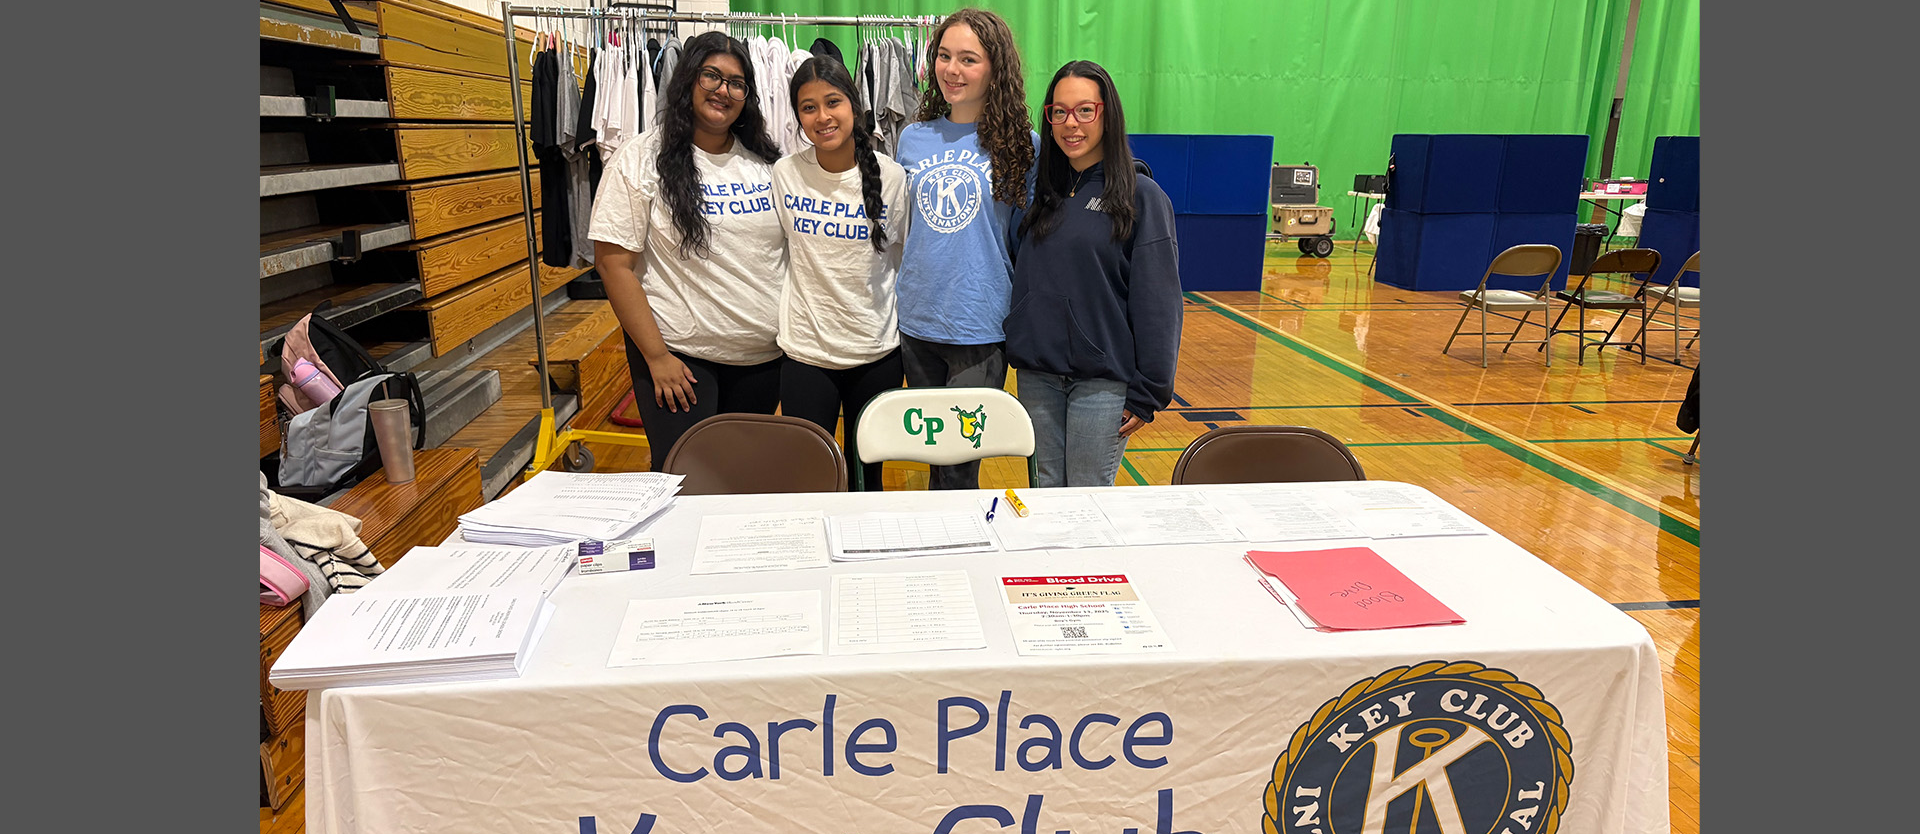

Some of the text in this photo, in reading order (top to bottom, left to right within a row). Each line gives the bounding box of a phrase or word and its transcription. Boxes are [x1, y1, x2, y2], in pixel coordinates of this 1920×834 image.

[927, 169, 973, 185] KEY CLUB
[728, 197, 771, 215] CLUB
[784, 194, 889, 220] CARLE PLAE
[921, 192, 976, 228] INTERNATIONAL
[793, 216, 869, 240] KEY CLUB
[1329, 581, 1373, 598] Drive
[1353, 591, 1405, 610] Blood
[1326, 688, 1536, 753] KEY CLUB
[647, 689, 1175, 784] Carle Place
